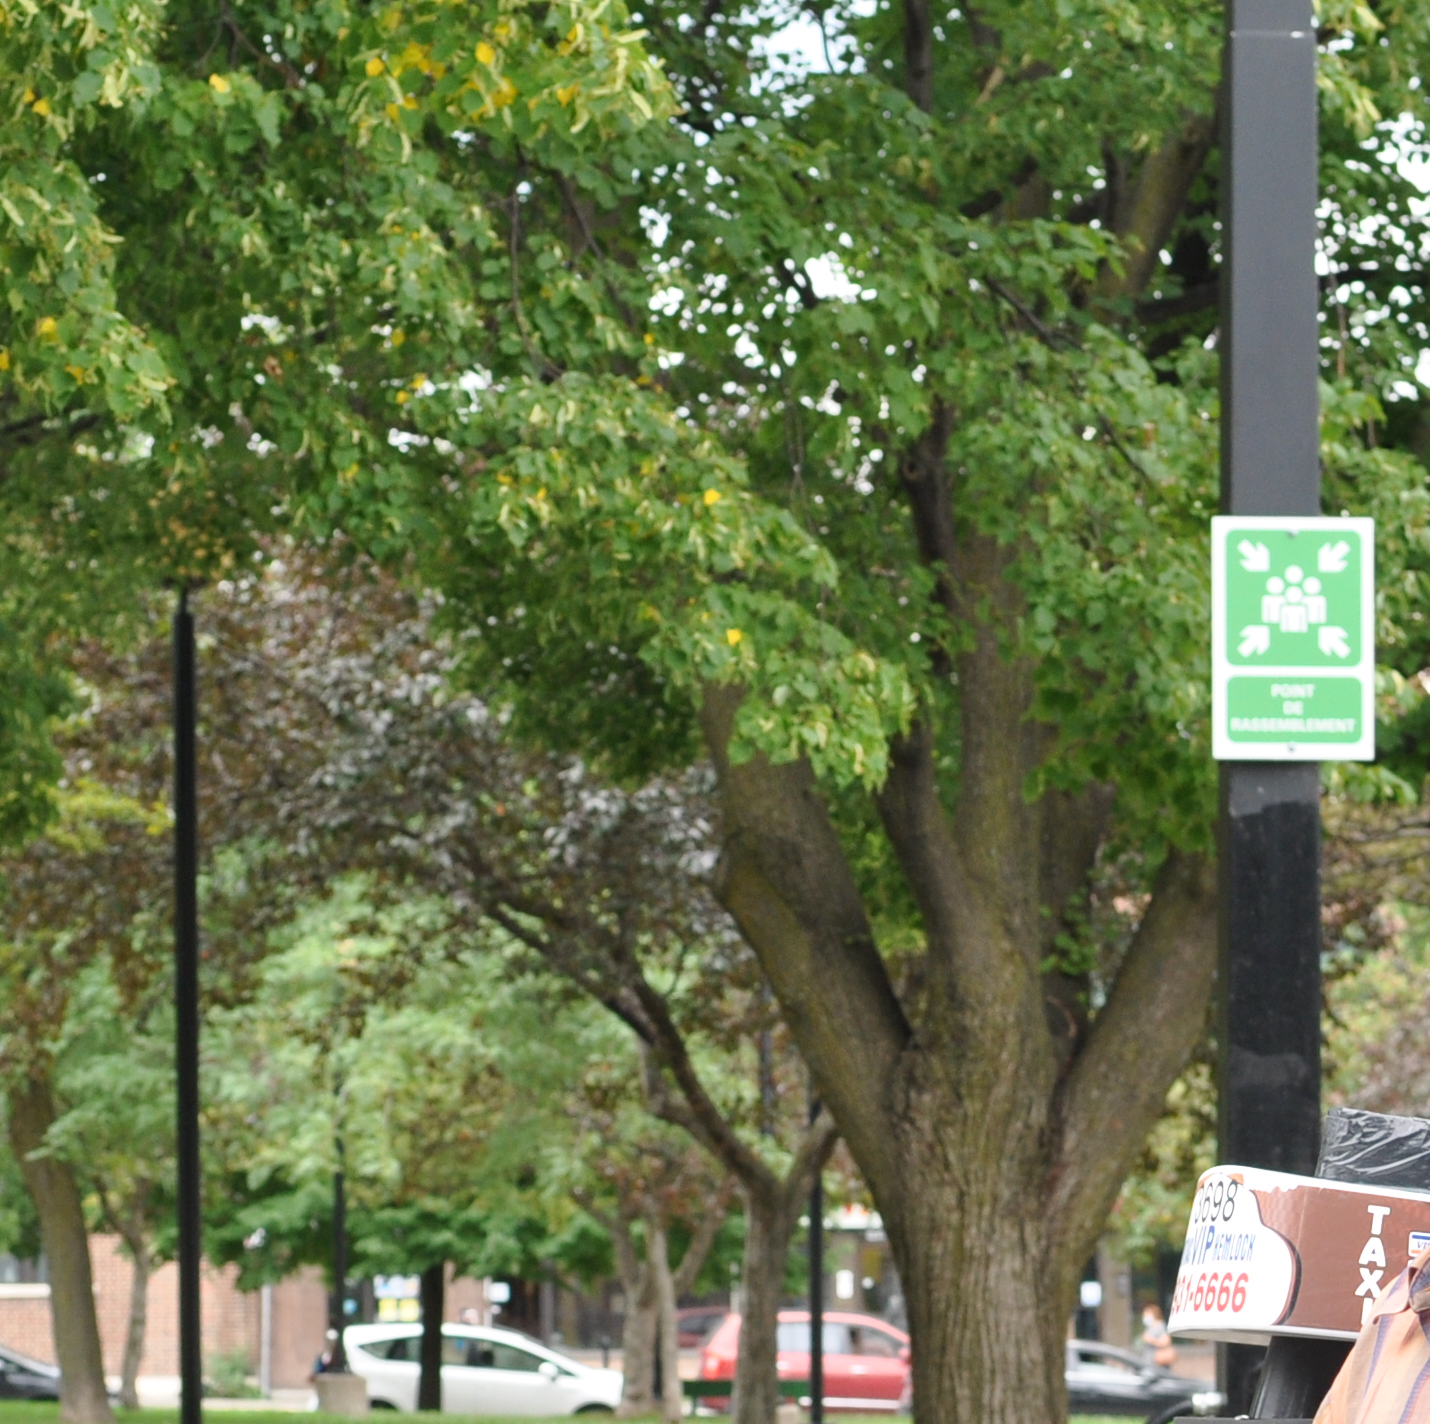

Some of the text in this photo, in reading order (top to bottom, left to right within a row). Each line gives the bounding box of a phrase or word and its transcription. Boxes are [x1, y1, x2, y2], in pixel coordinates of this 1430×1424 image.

[1271, 683, 1315, 698] POINT
[1283, 700, 1304, 715] DE
[1230, 717, 1356, 733] RASSEMBLEMENT
[1194, 1179, 1238, 1224] 3698
